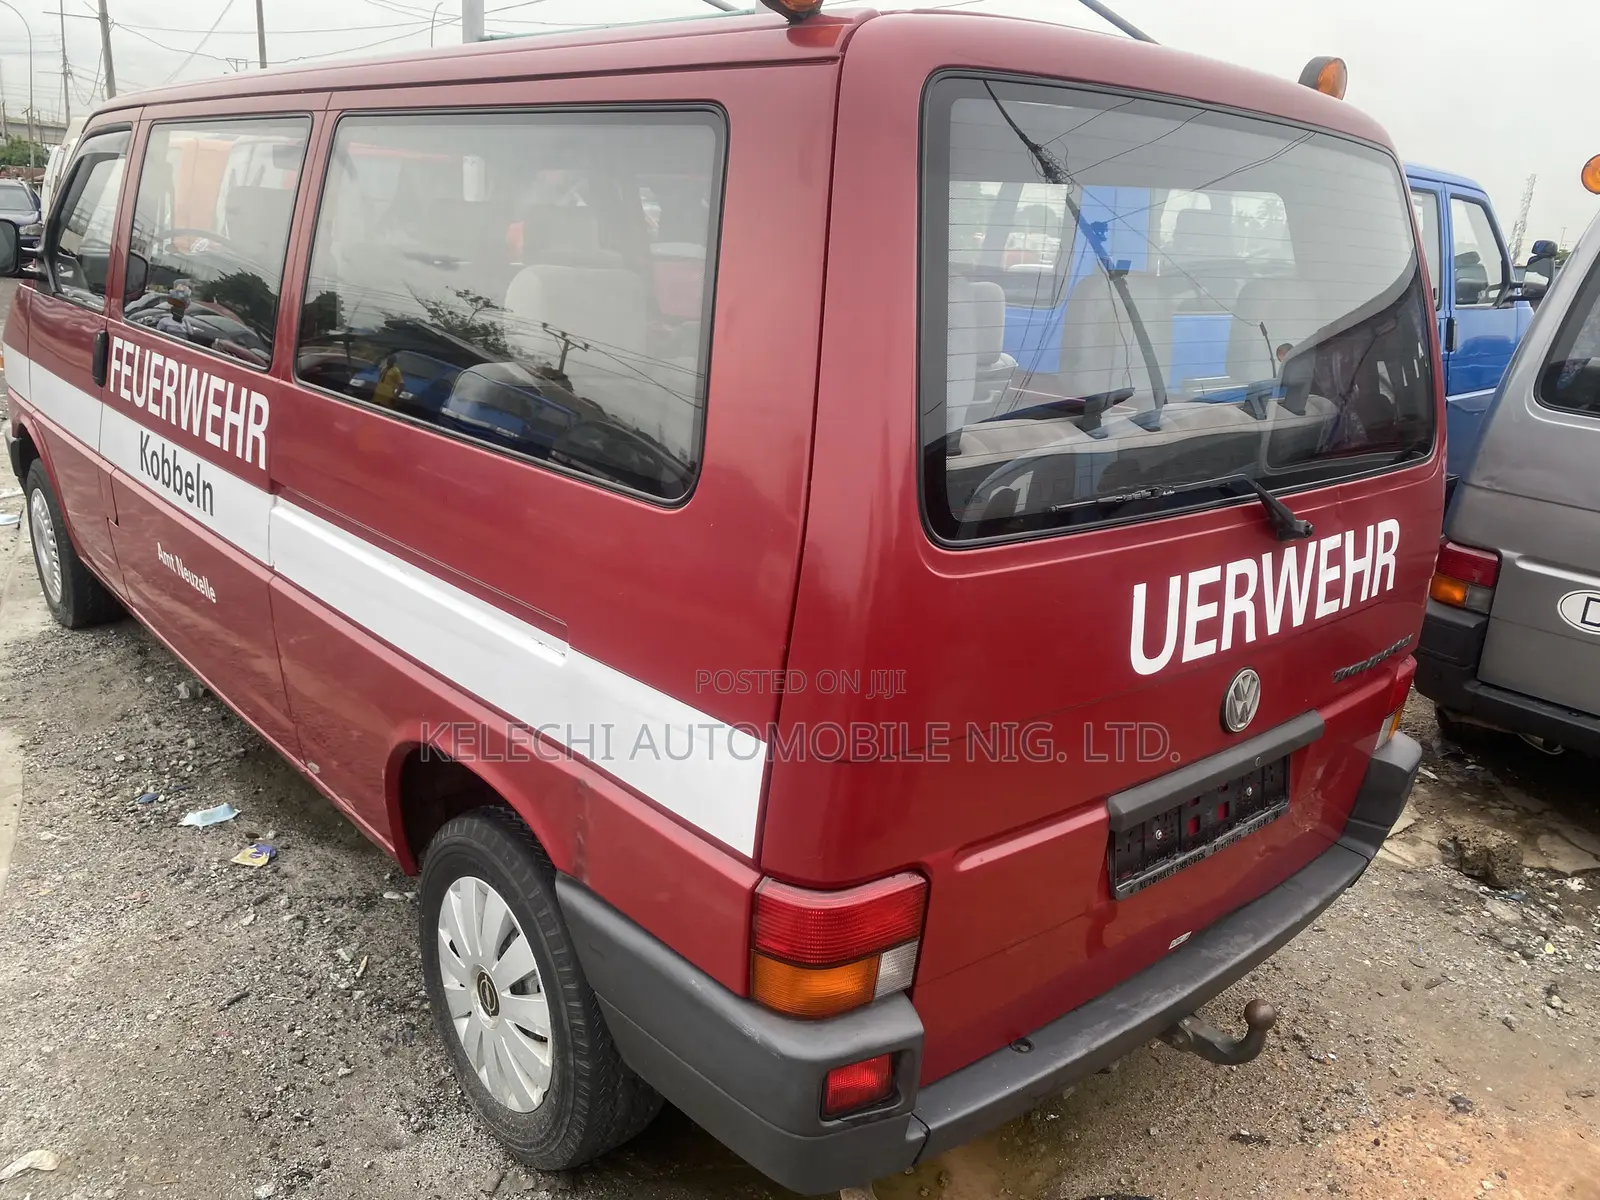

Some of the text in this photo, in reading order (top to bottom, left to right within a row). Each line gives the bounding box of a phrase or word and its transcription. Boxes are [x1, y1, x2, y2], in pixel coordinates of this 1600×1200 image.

[109, 336, 270, 471] FEUERWEHR
[139, 430, 214, 516] Kobbeln
[157, 541, 217, 604] Amt Neuzelle
[1130, 518, 1400, 675] UERWEHR
